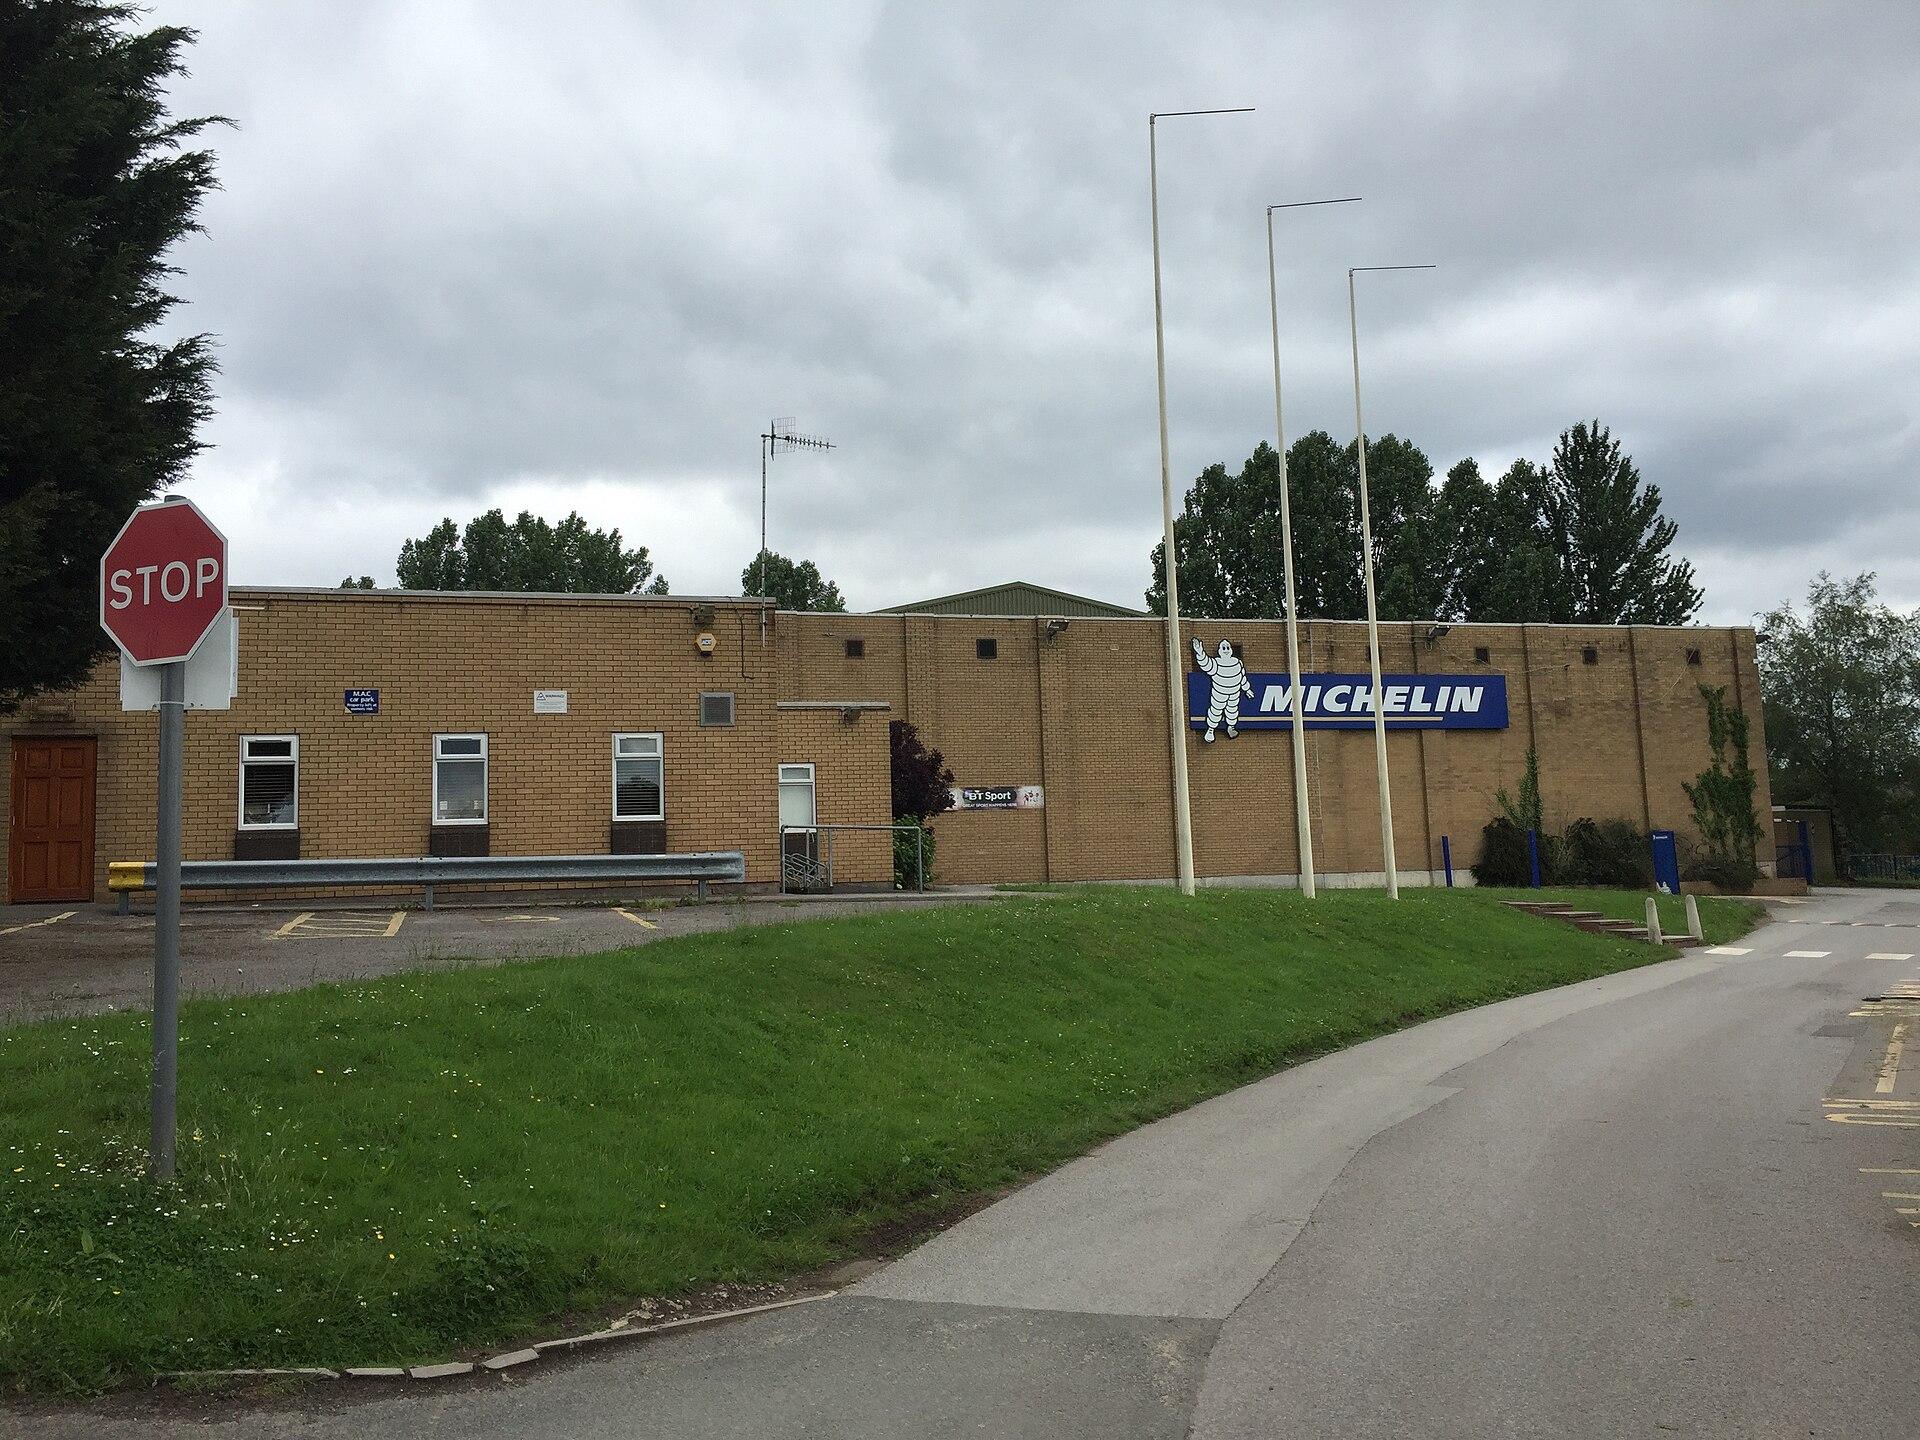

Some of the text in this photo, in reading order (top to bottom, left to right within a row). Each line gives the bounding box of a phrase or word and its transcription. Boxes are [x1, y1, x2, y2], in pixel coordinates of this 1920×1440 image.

[109, 557, 220, 610] STOP
[1259, 685, 1484, 713] MICHELIN
[968, 791, 1011, 801] BT Sport
